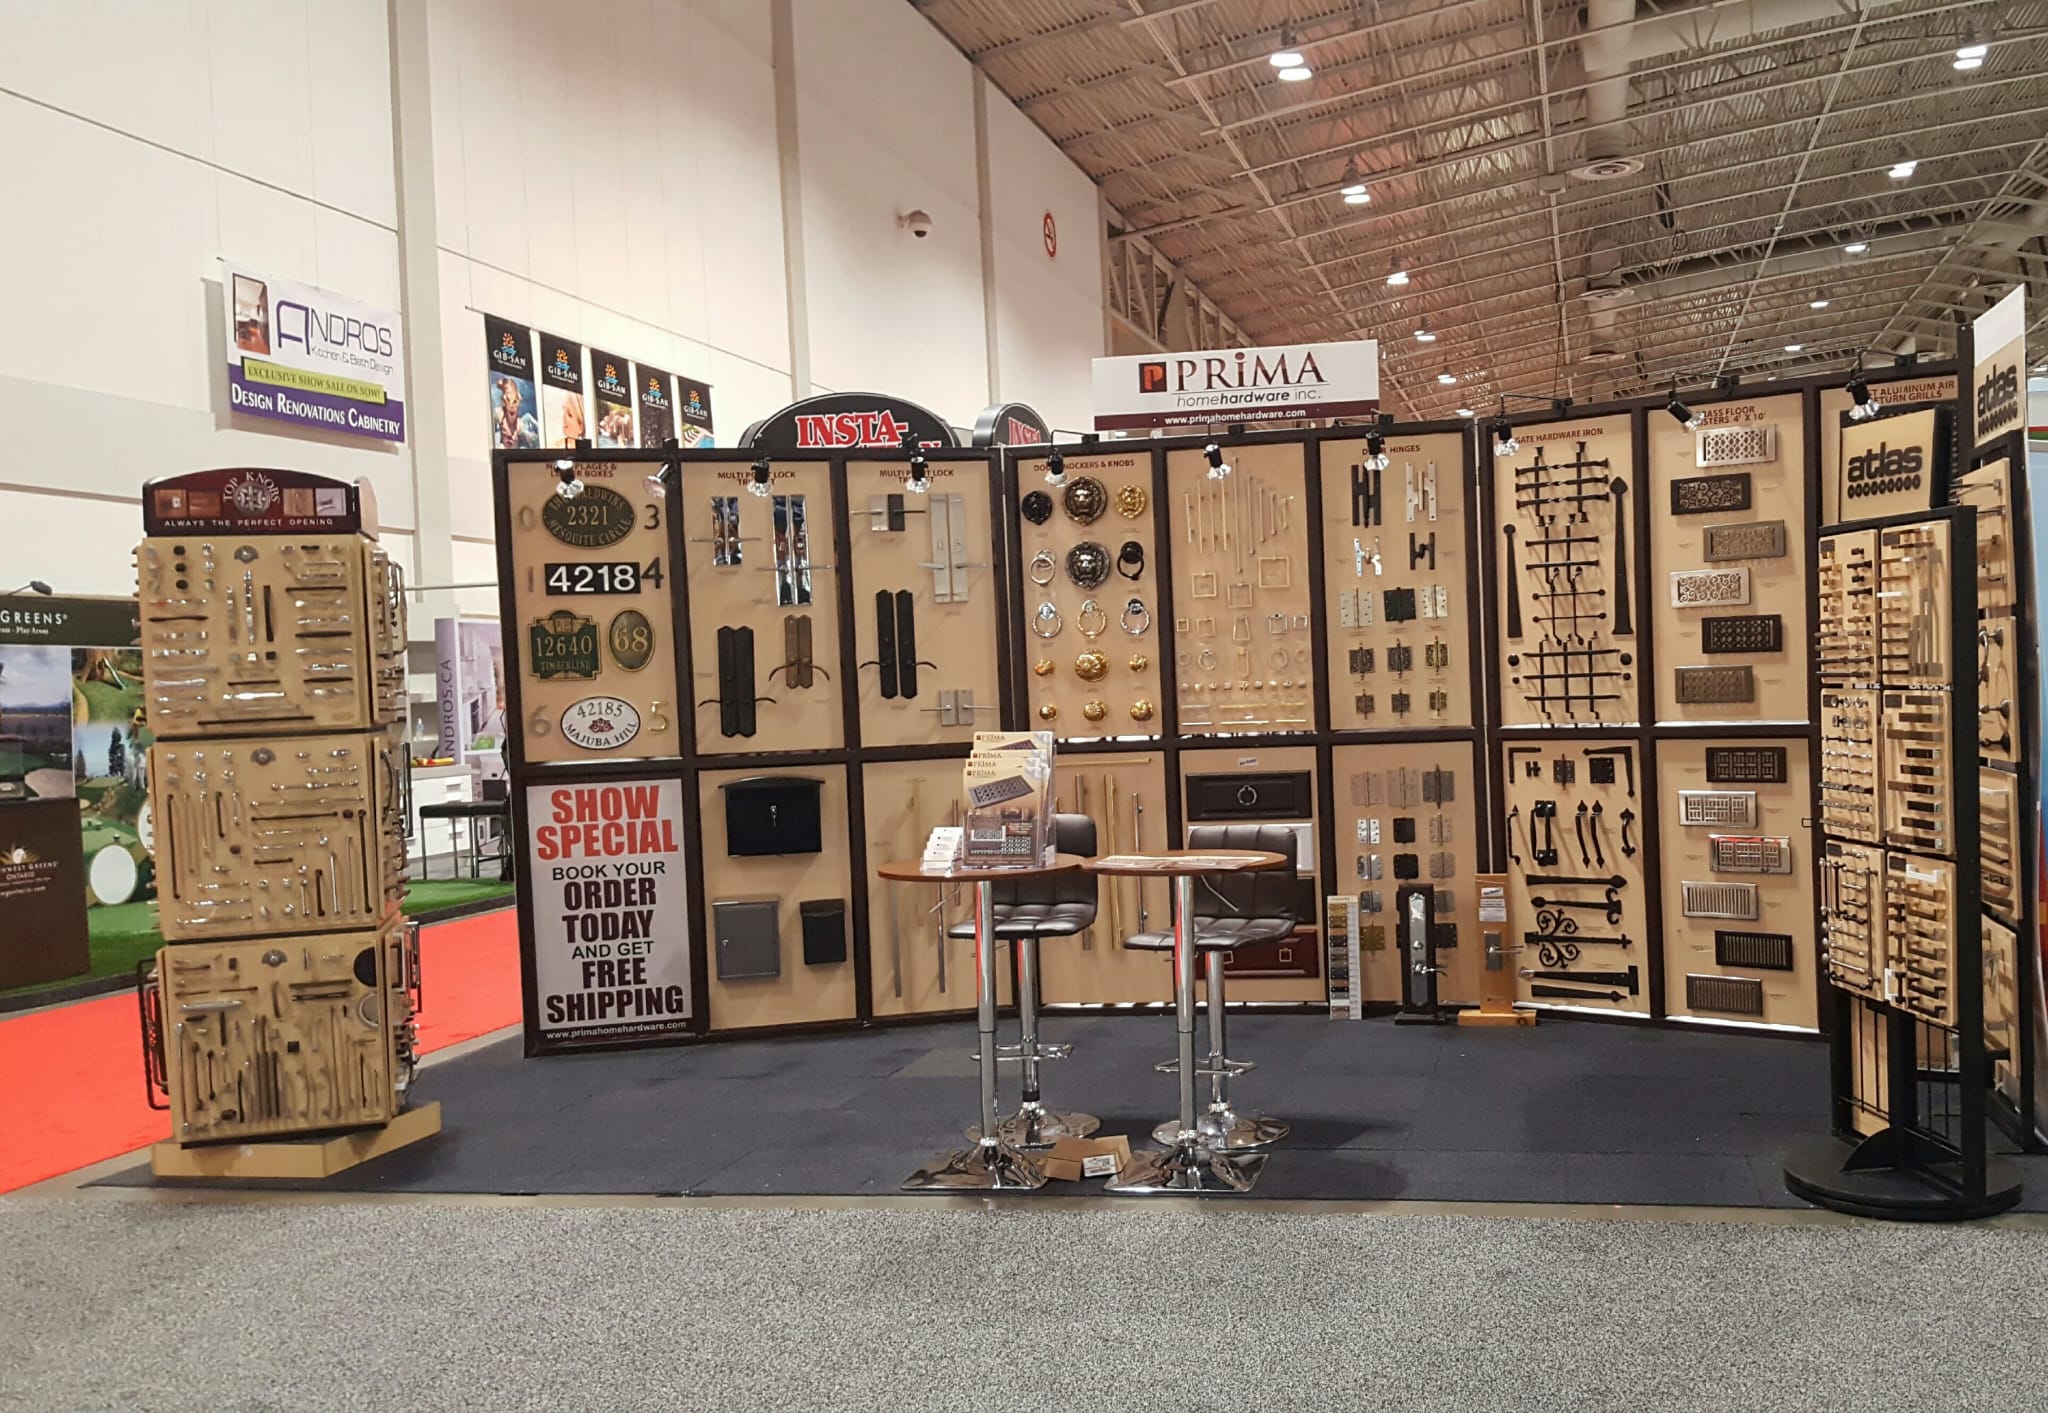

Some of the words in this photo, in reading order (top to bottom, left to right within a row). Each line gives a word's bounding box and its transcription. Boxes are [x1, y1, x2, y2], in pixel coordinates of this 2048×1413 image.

[276, 300, 393, 357] ANDROS
[248, 366, 296, 384] EXCLUSIVE
[298, 375, 324, 389] SHOW
[325, 379, 345, 392] SALE
[346, 383, 358, 394] ON
[359, 385, 381, 398] NOW!
[1938, 380, 1955, 390] AIR
[1294, 388, 1322, 401] inc.
[1908, 390, 1943, 401] GRILLS
[231, 383, 273, 411] DESIGN
[277, 392, 346, 425] RENOVATIONS
[347, 408, 401, 436] CABINETRY
[1164, 408, 1306, 425] www.primahomehardware.com
[1725, 405, 1755, 416] FLOOR
[1536, 429, 1581, 442] HARDWARE
[1582, 427, 1604, 437] IRON
[1389, 445, 1421, 454] HINGES
[1064, 461, 1100, 470] NOCKERS
[1108, 459, 1135, 467] KNOBS
[1847, 441, 1923, 482] atlas
[585, 470, 614, 478] BOXES
[718, 471, 744, 480] MULTI
[880, 469, 904, 477] MULTI
[933, 469, 955, 477] LOCK
[223, 476, 239, 501] TOP
[246, 471, 281, 504] KNOBS
[164, 519, 205, 527] ALWAYS
[212, 519, 230, 527] THE
[238, 519, 282, 527] PERFECT
[289, 518, 334, 526] OPENING
[567, 505, 608, 525] 2321
[643, 504, 661, 530] 3
[551, 518, 595, 546] MESQUITE
[599, 517, 633, 546] CIRCLE
[549, 564, 636, 593] 4218
[641, 556, 665, 589] 4
[536, 635, 592, 657] 12640
[614, 626, 649, 652] 68
[540, 659, 591, 671] TIMBERLINE
[577, 701, 623, 719] 42185
[648, 700, 669, 732] 5
[564, 721, 611, 747] MAJUBA
[614, 721, 638, 744] HILL
[551, 785, 660, 824] SHOW
[536, 819, 679, 861] SPECIAL
[552, 864, 607, 881] BOOK
[612, 861, 666, 876] YOUR
[564, 877, 657, 910] ORDER
[562, 910, 654, 943] TODAY
[571, 944, 611, 960] AND
[617, 941, 655, 956] GET
[582, 957, 647, 989] FREE
[546, 985, 684, 1024] SHIPPING
[546, 1021, 687, 1039] www.primahomehardware.com
